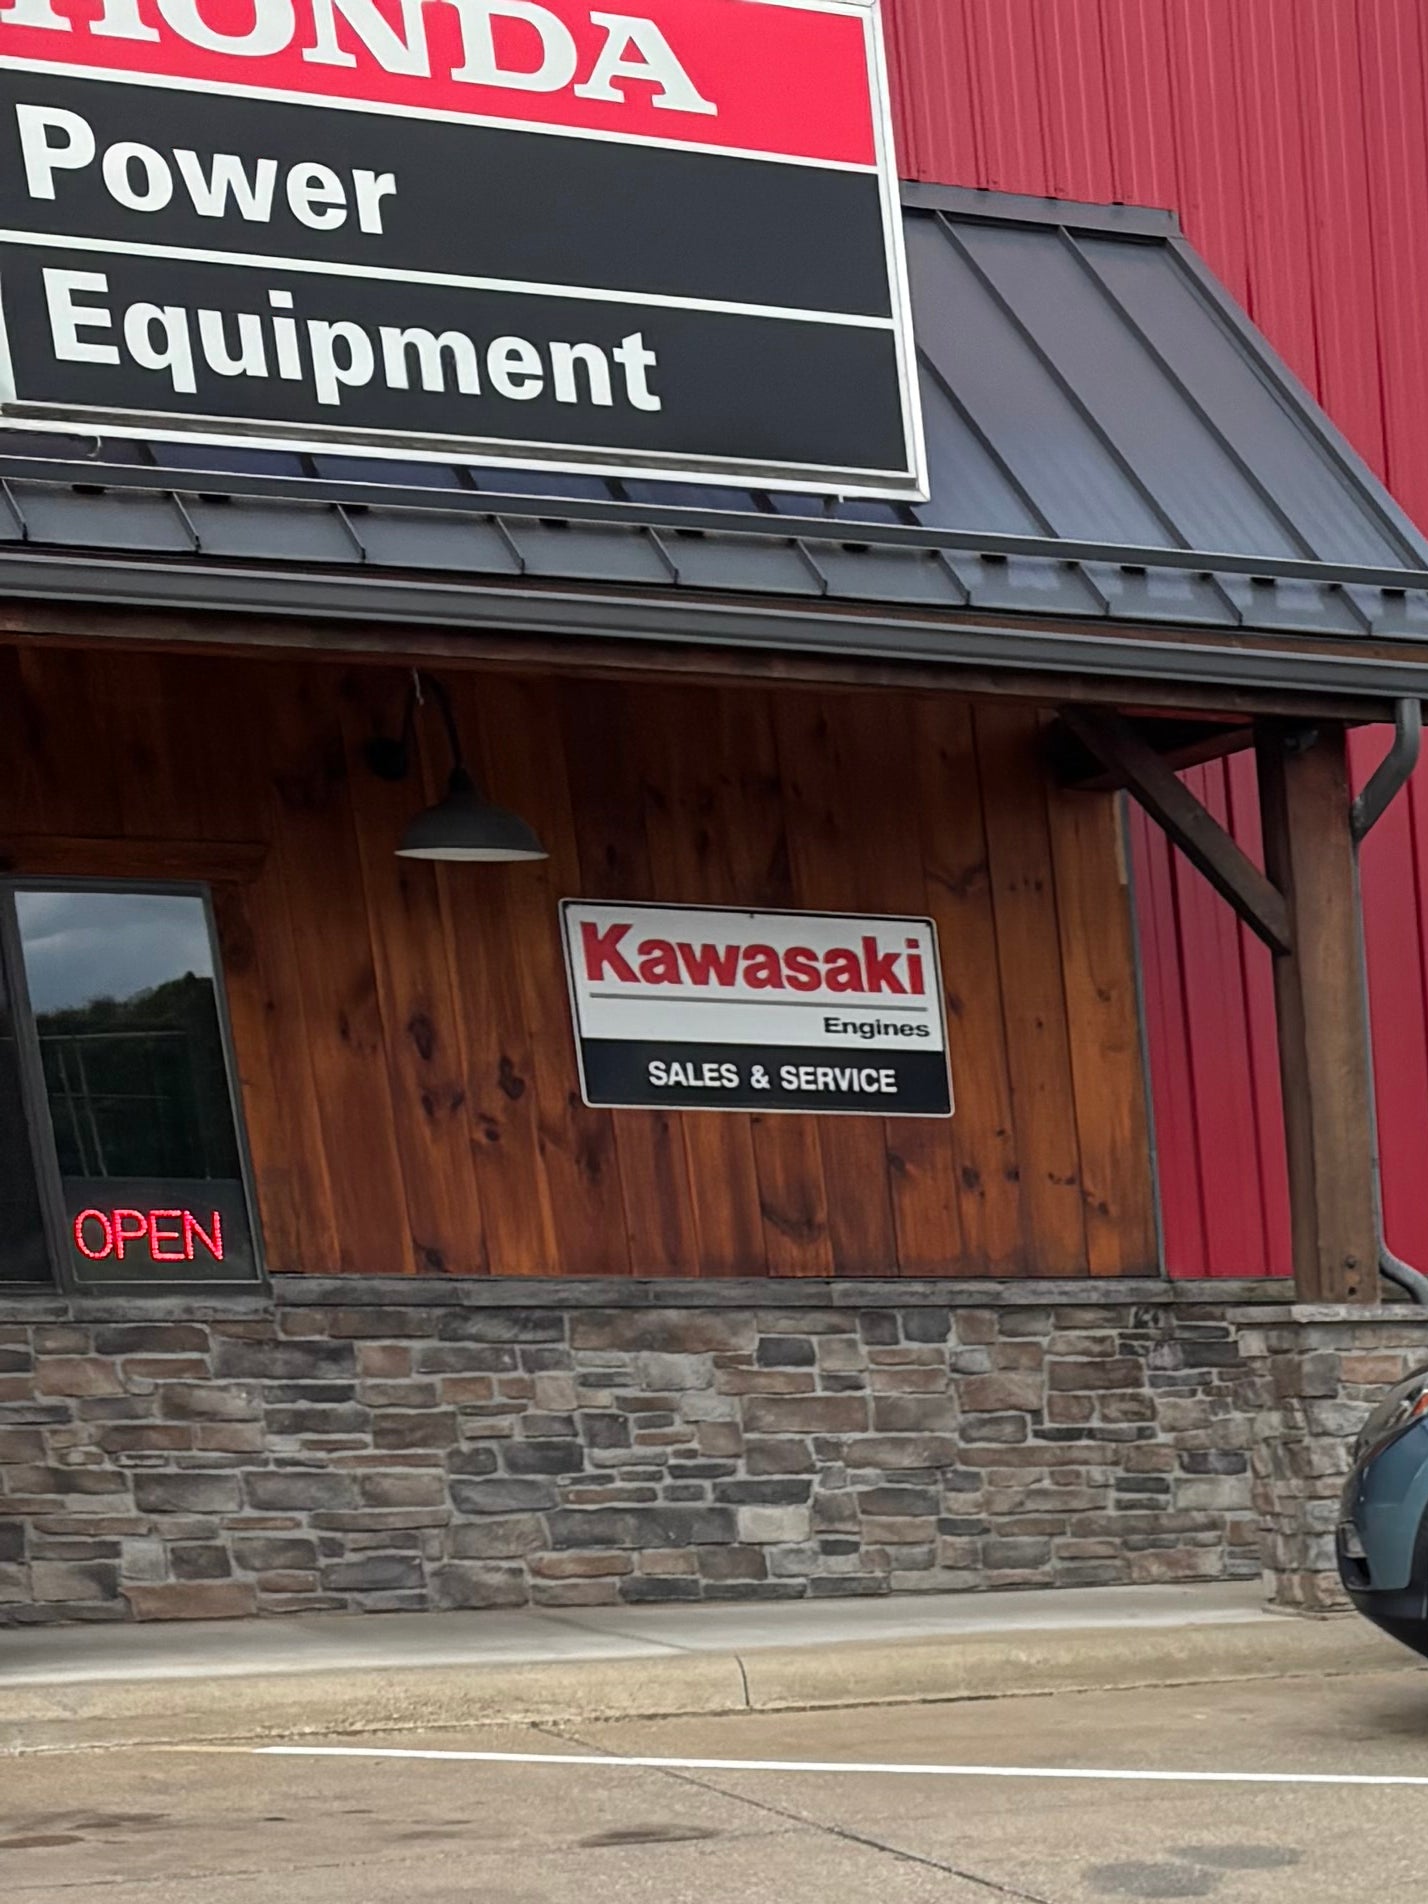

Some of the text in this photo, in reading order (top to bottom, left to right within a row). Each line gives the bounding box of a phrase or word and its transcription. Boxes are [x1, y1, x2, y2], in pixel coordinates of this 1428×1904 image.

[15, 104, 396, 234] Power
[42, 268, 661, 412] Equipment
[579, 920, 926, 996] Kawasaki
[823, 1016, 931, 1039] Engines
[648, 1060, 898, 1094] SALES & SERVICE
[73, 1208, 224, 1263] OPEN
